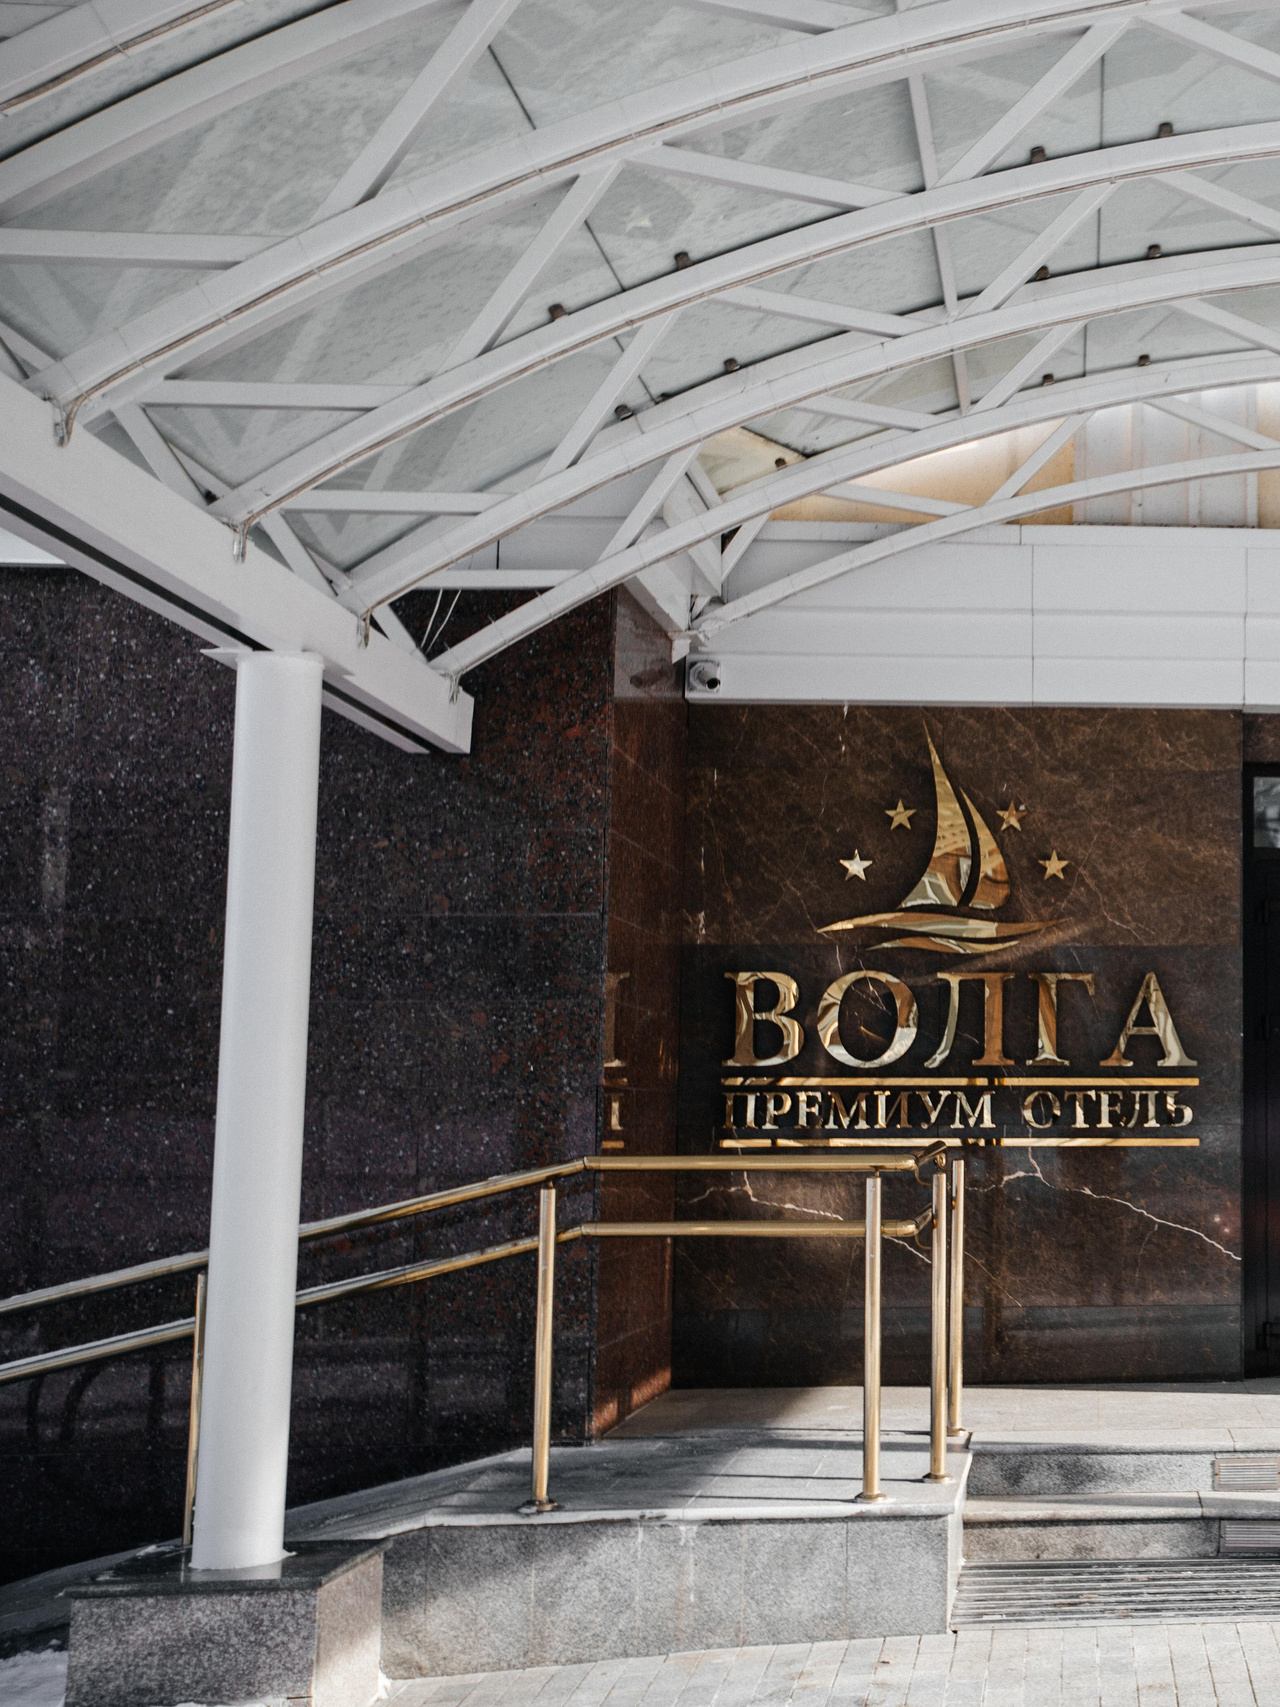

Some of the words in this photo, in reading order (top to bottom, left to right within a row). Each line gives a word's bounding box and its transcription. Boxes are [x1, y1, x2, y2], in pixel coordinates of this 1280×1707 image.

[722, 970, 1198, 1068] ВОЛГА
[722, 1090, 997, 1130] ПРЕМИУМ
[1022, 1090, 1194, 1130] ОТЕЛЬ
